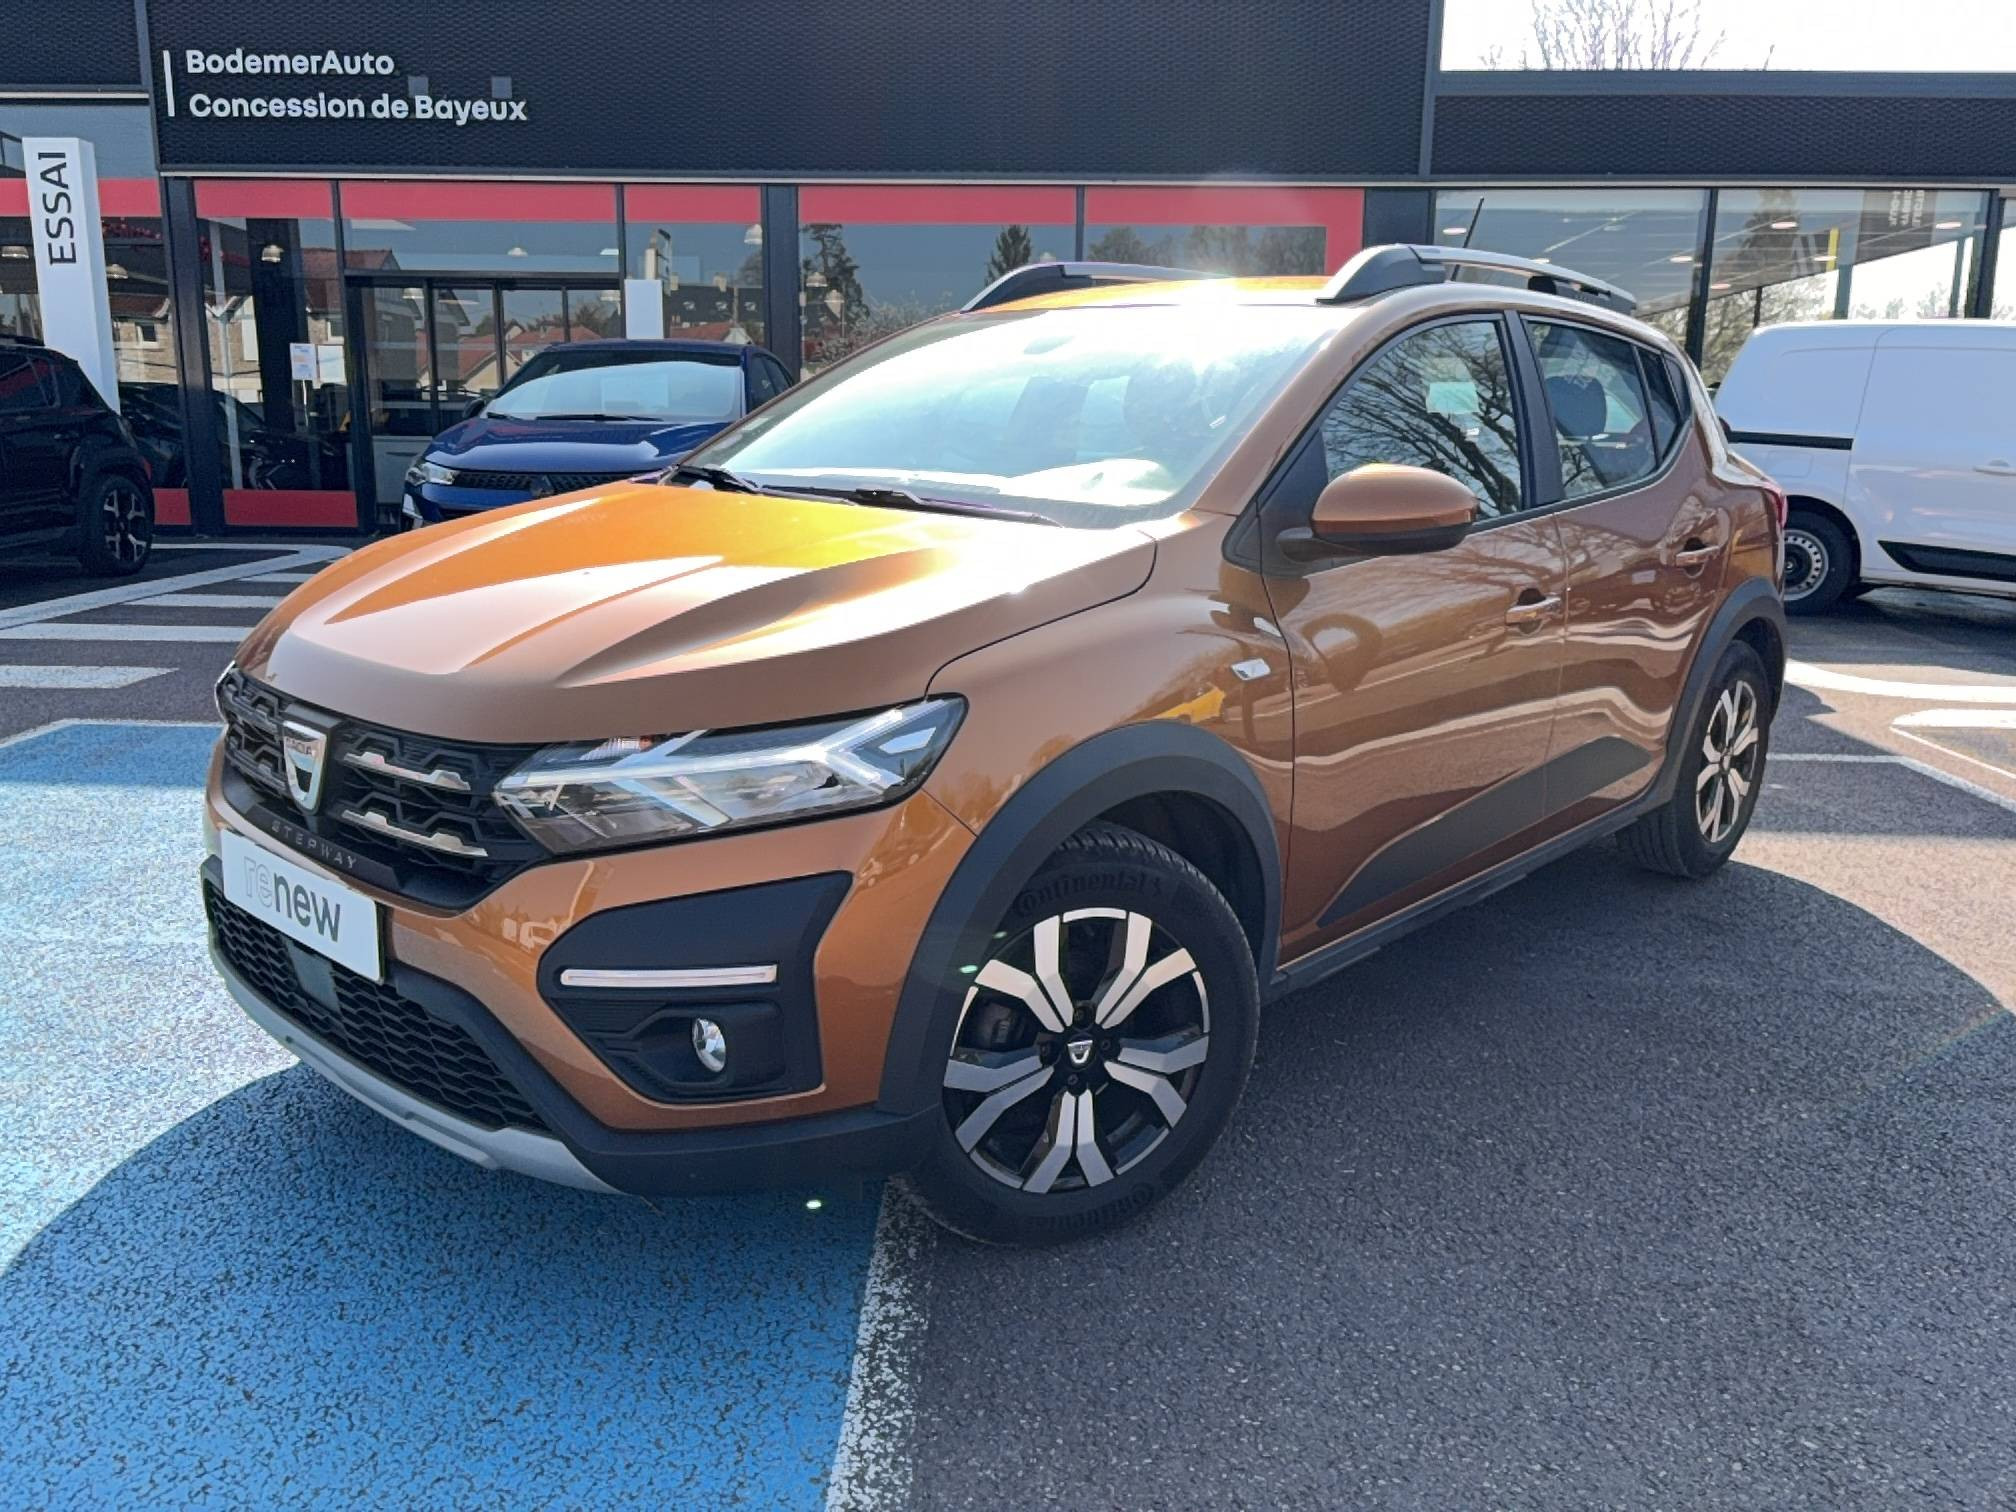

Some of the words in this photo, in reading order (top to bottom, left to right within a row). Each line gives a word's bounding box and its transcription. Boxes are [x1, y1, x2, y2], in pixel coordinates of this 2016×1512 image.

[186, 49, 395, 74] BodemerAuto
[189, 93, 366, 118] Concession
[371, 93, 409, 119] de
[414, 95, 527, 126] Bayeux
[38, 152, 77, 265] ESSAI
[271, 820, 357, 869] STEPWAY
[243, 855, 341, 943] renew
